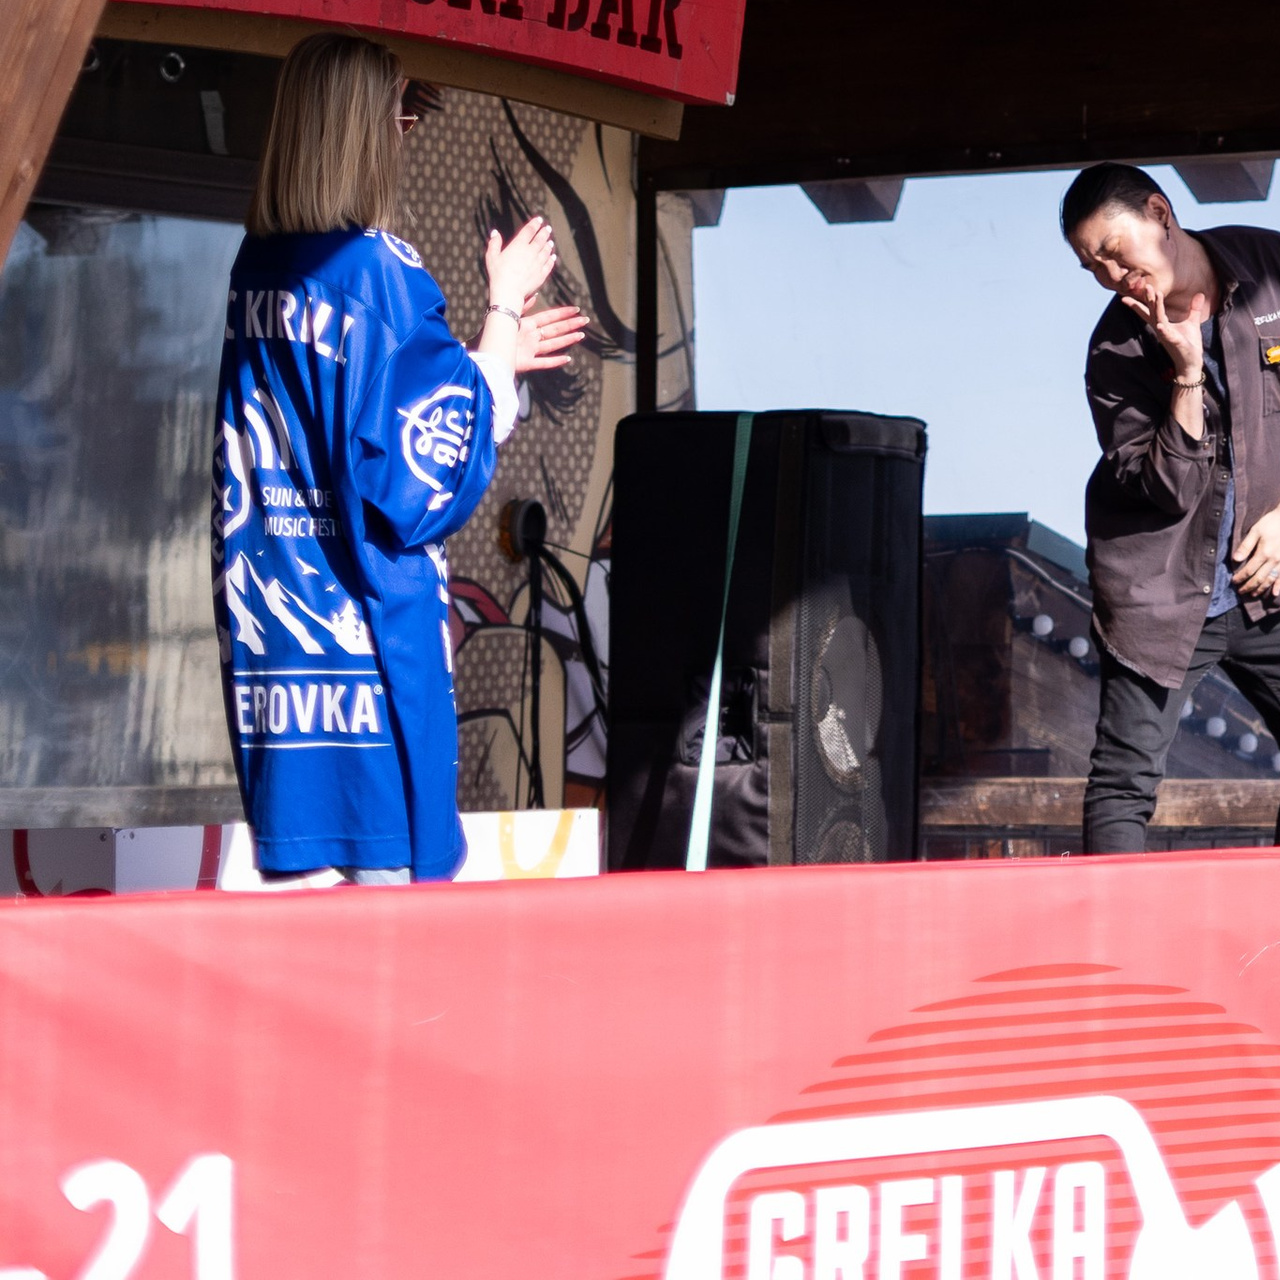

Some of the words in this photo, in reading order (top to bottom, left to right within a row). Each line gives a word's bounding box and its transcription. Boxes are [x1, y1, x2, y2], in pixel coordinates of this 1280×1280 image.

[262, 486, 293, 507] SUN
[294, 489, 306, 507] &
[264, 516, 306, 537] MUSIC
